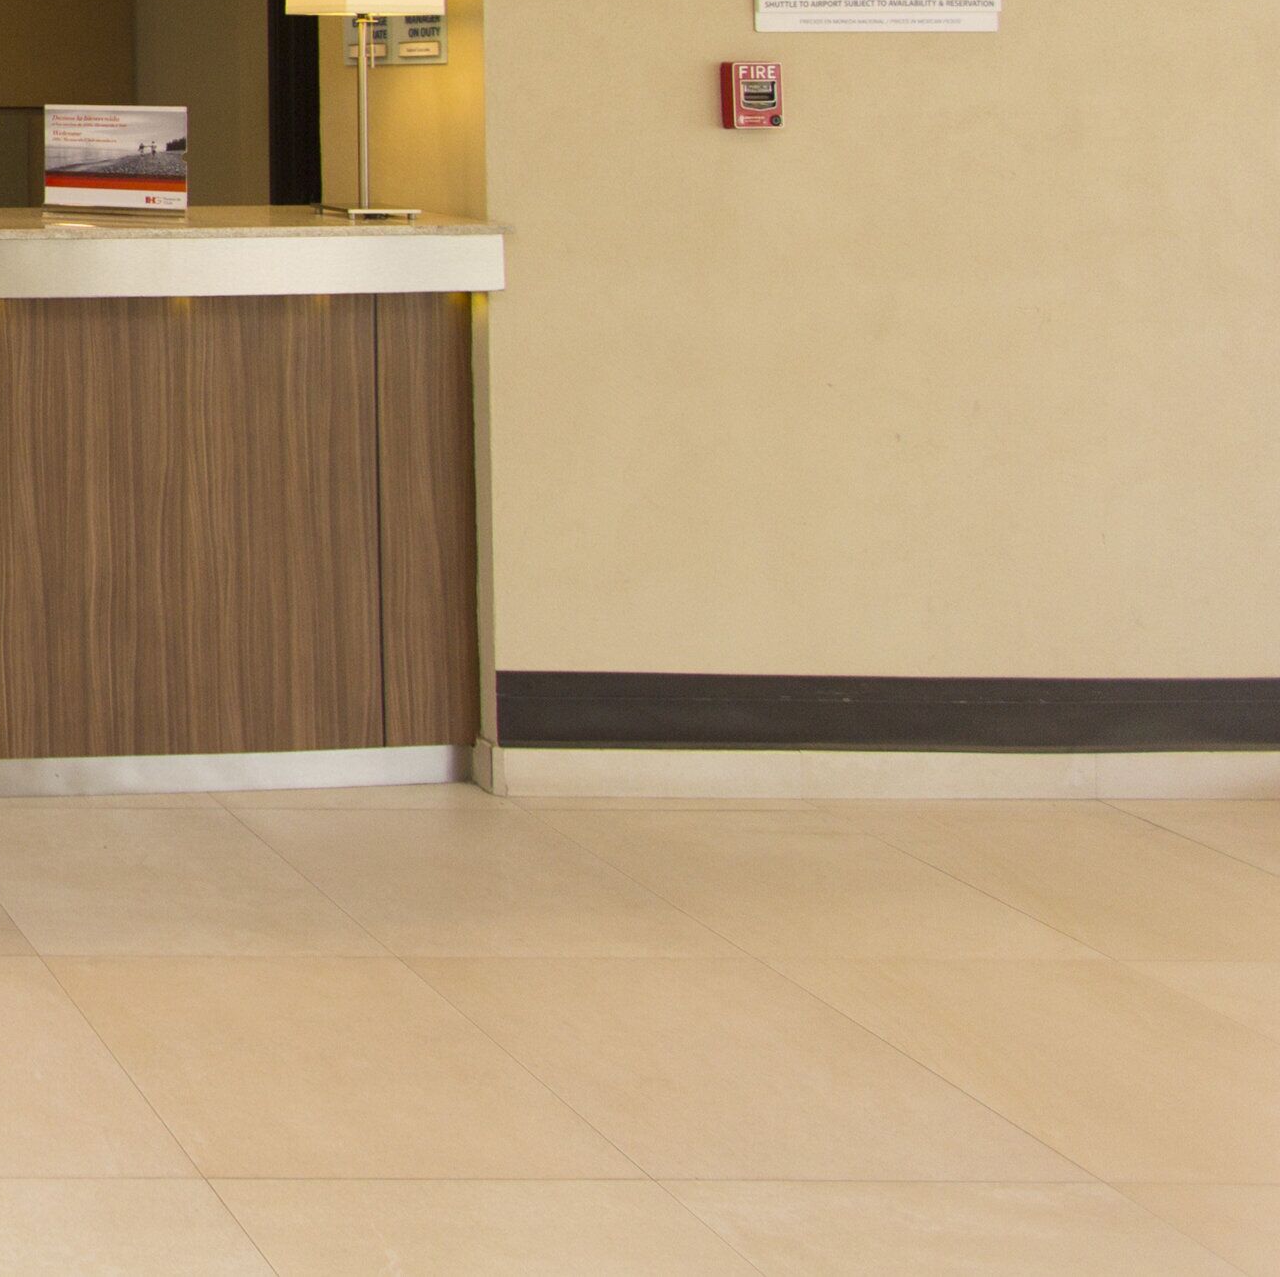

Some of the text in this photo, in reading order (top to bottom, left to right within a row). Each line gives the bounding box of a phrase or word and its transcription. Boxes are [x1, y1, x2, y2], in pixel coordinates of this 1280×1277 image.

[811, 0, 842, 8] AIRPORT
[408, 26, 441, 38] ON DUTY
[738, 66, 776, 79] FIRE
